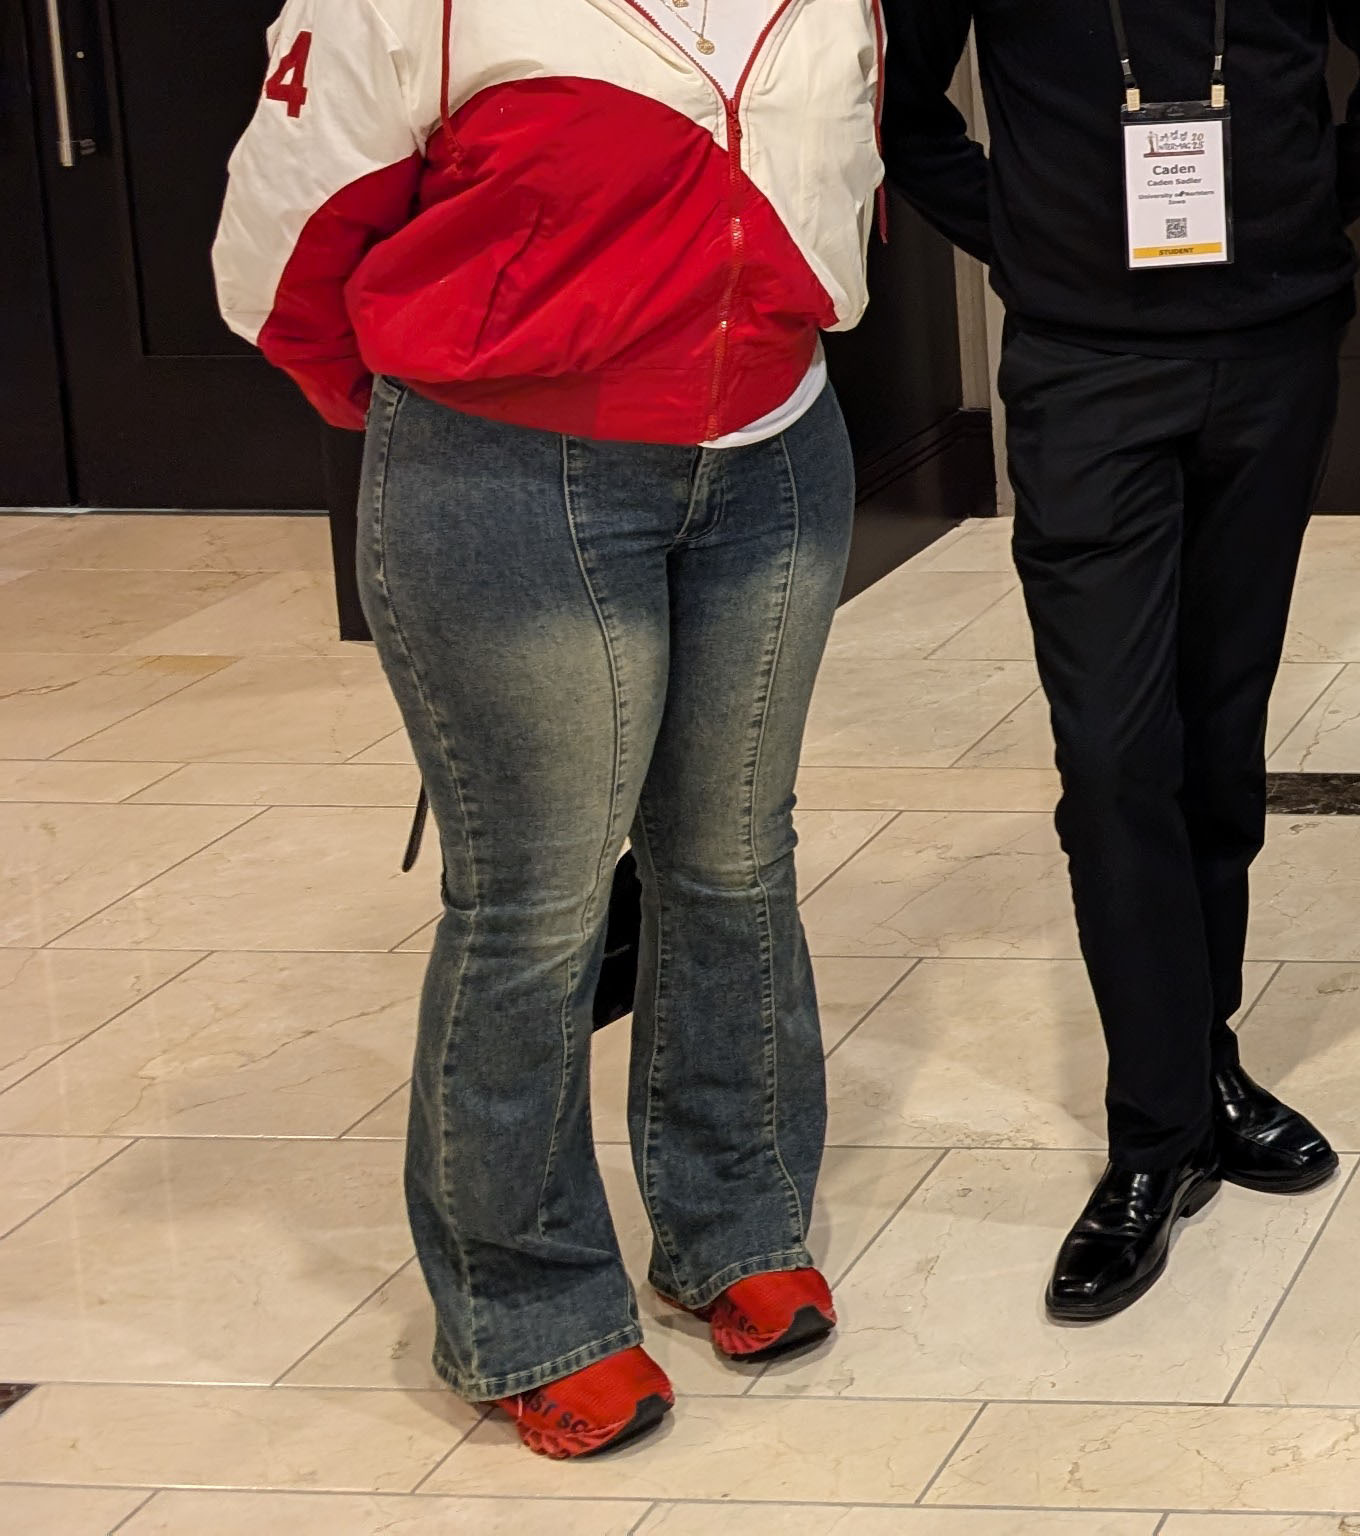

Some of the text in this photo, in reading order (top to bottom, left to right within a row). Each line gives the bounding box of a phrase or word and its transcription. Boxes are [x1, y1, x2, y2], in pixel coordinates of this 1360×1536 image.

[264, 30, 313, 118] 4
[1152, 164, 1196, 175] Caden
[1159, 247, 1194, 256] STUDENT
